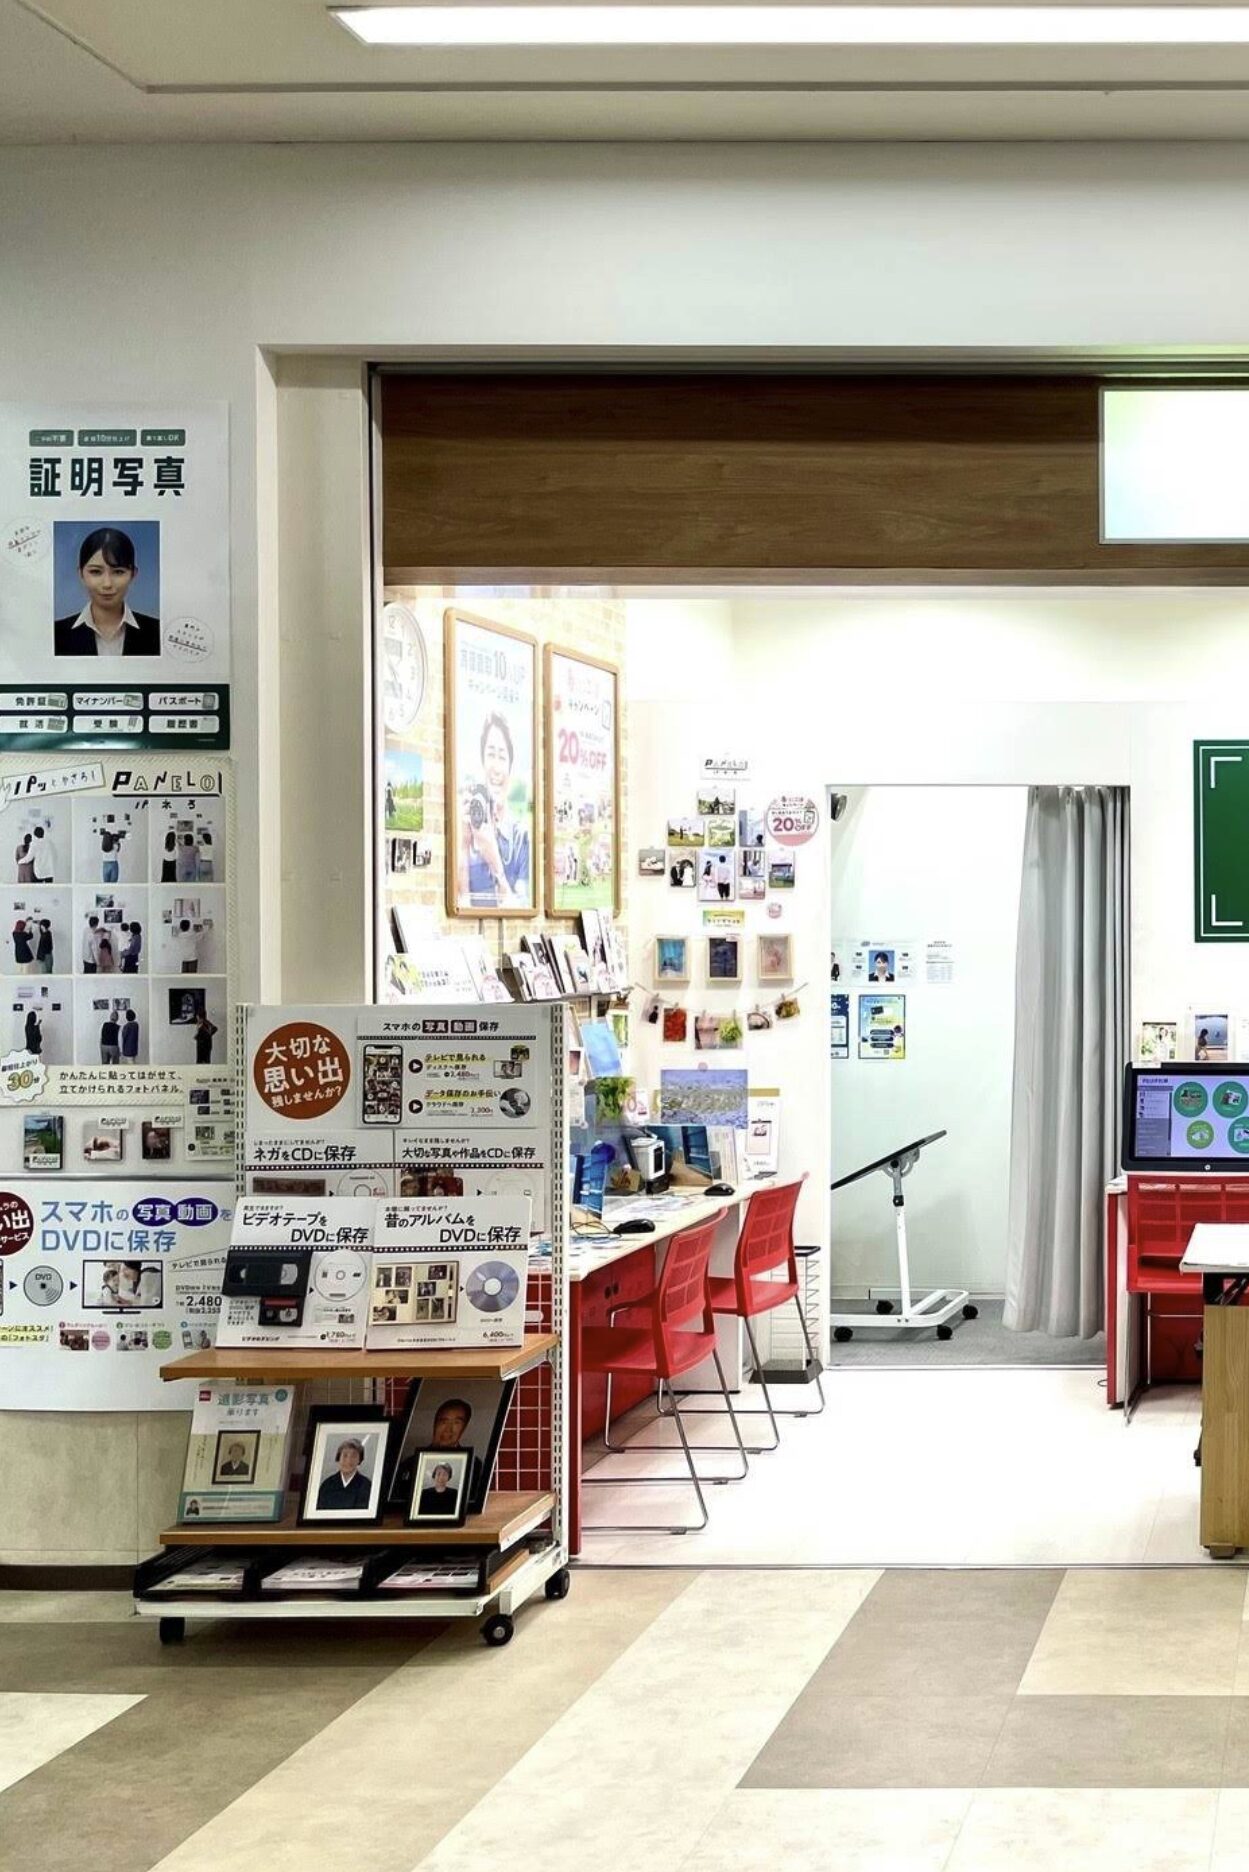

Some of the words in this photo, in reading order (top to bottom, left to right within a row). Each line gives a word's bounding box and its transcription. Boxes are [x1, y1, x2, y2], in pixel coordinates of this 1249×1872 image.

[29, 456, 185, 497] 証明写真
[112, 771, 215, 792] PANELO
[264, 1034, 331, 1065] 大切な
[59, 1070, 183, 1081] かんたんに貼ってはがせて、
[263, 1056, 344, 1094] 思い出
[59, 1084, 184, 1094] 立てかけられるフォトパネル。
[253, 1145, 357, 1162] ネガをCDに保存
[402, 1146, 536, 1160] 大切な写真や作品をCDに保存
[243, 1212, 328, 1227] ビデオテープを
[385, 1213, 475, 1228] 昔のアルバムを
[42, 1229, 177, 1253] DVDに保存
[291, 1227, 369, 1243] DVDに保存
[440, 1226, 522, 1243] DVDに保存
